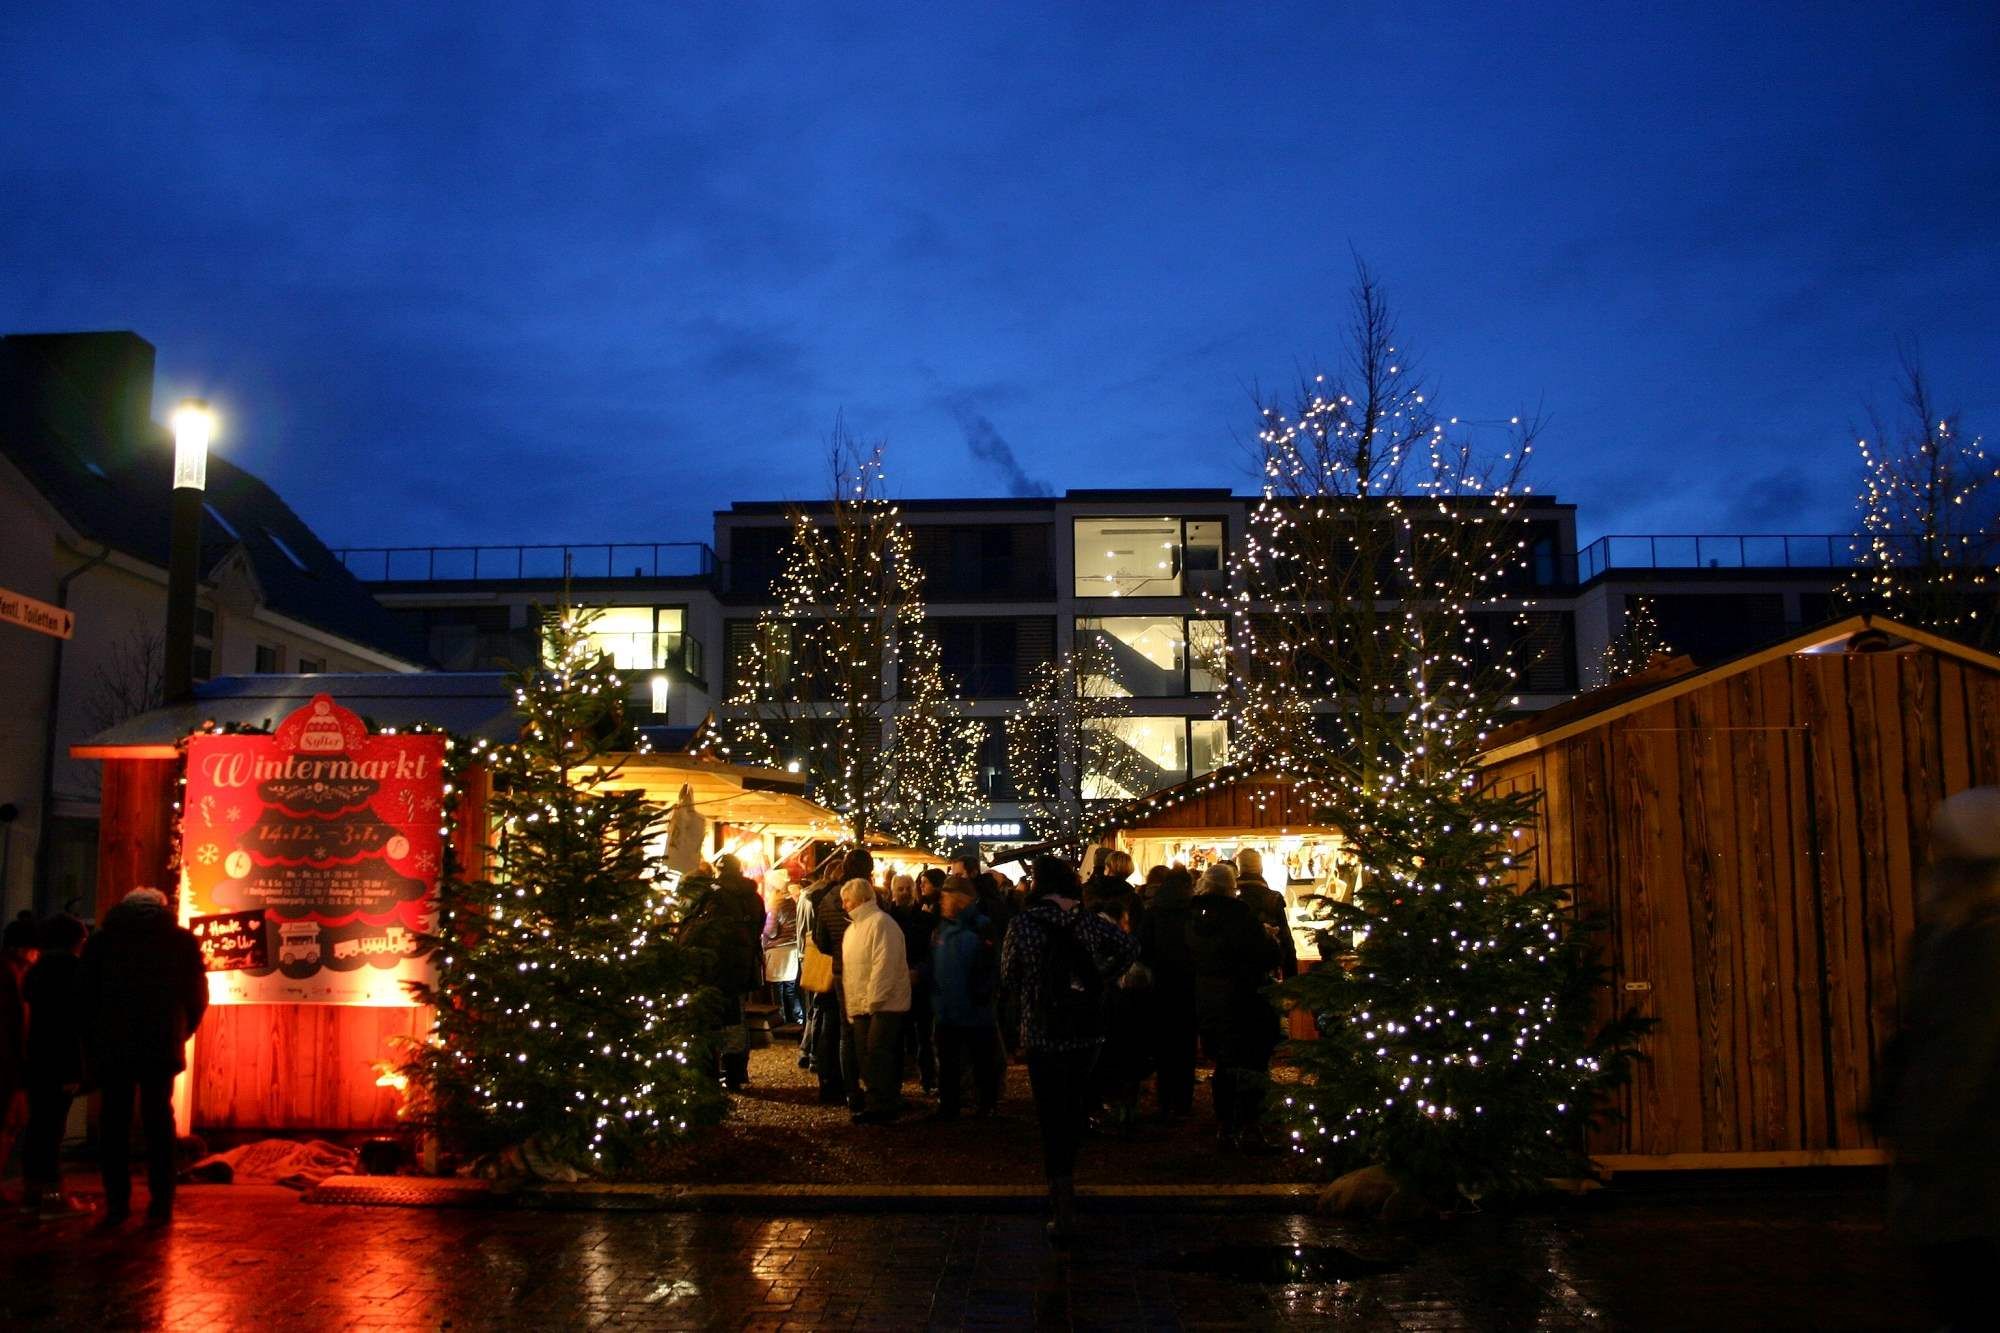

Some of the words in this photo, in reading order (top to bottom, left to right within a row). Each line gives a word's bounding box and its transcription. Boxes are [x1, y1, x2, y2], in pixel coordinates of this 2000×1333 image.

[23, 604, 59, 630] Toiletten
[304, 735, 341, 748] Sylter
[202, 750, 429, 788] Wintermarkt
[259, 826, 320, 844] 14.12.
